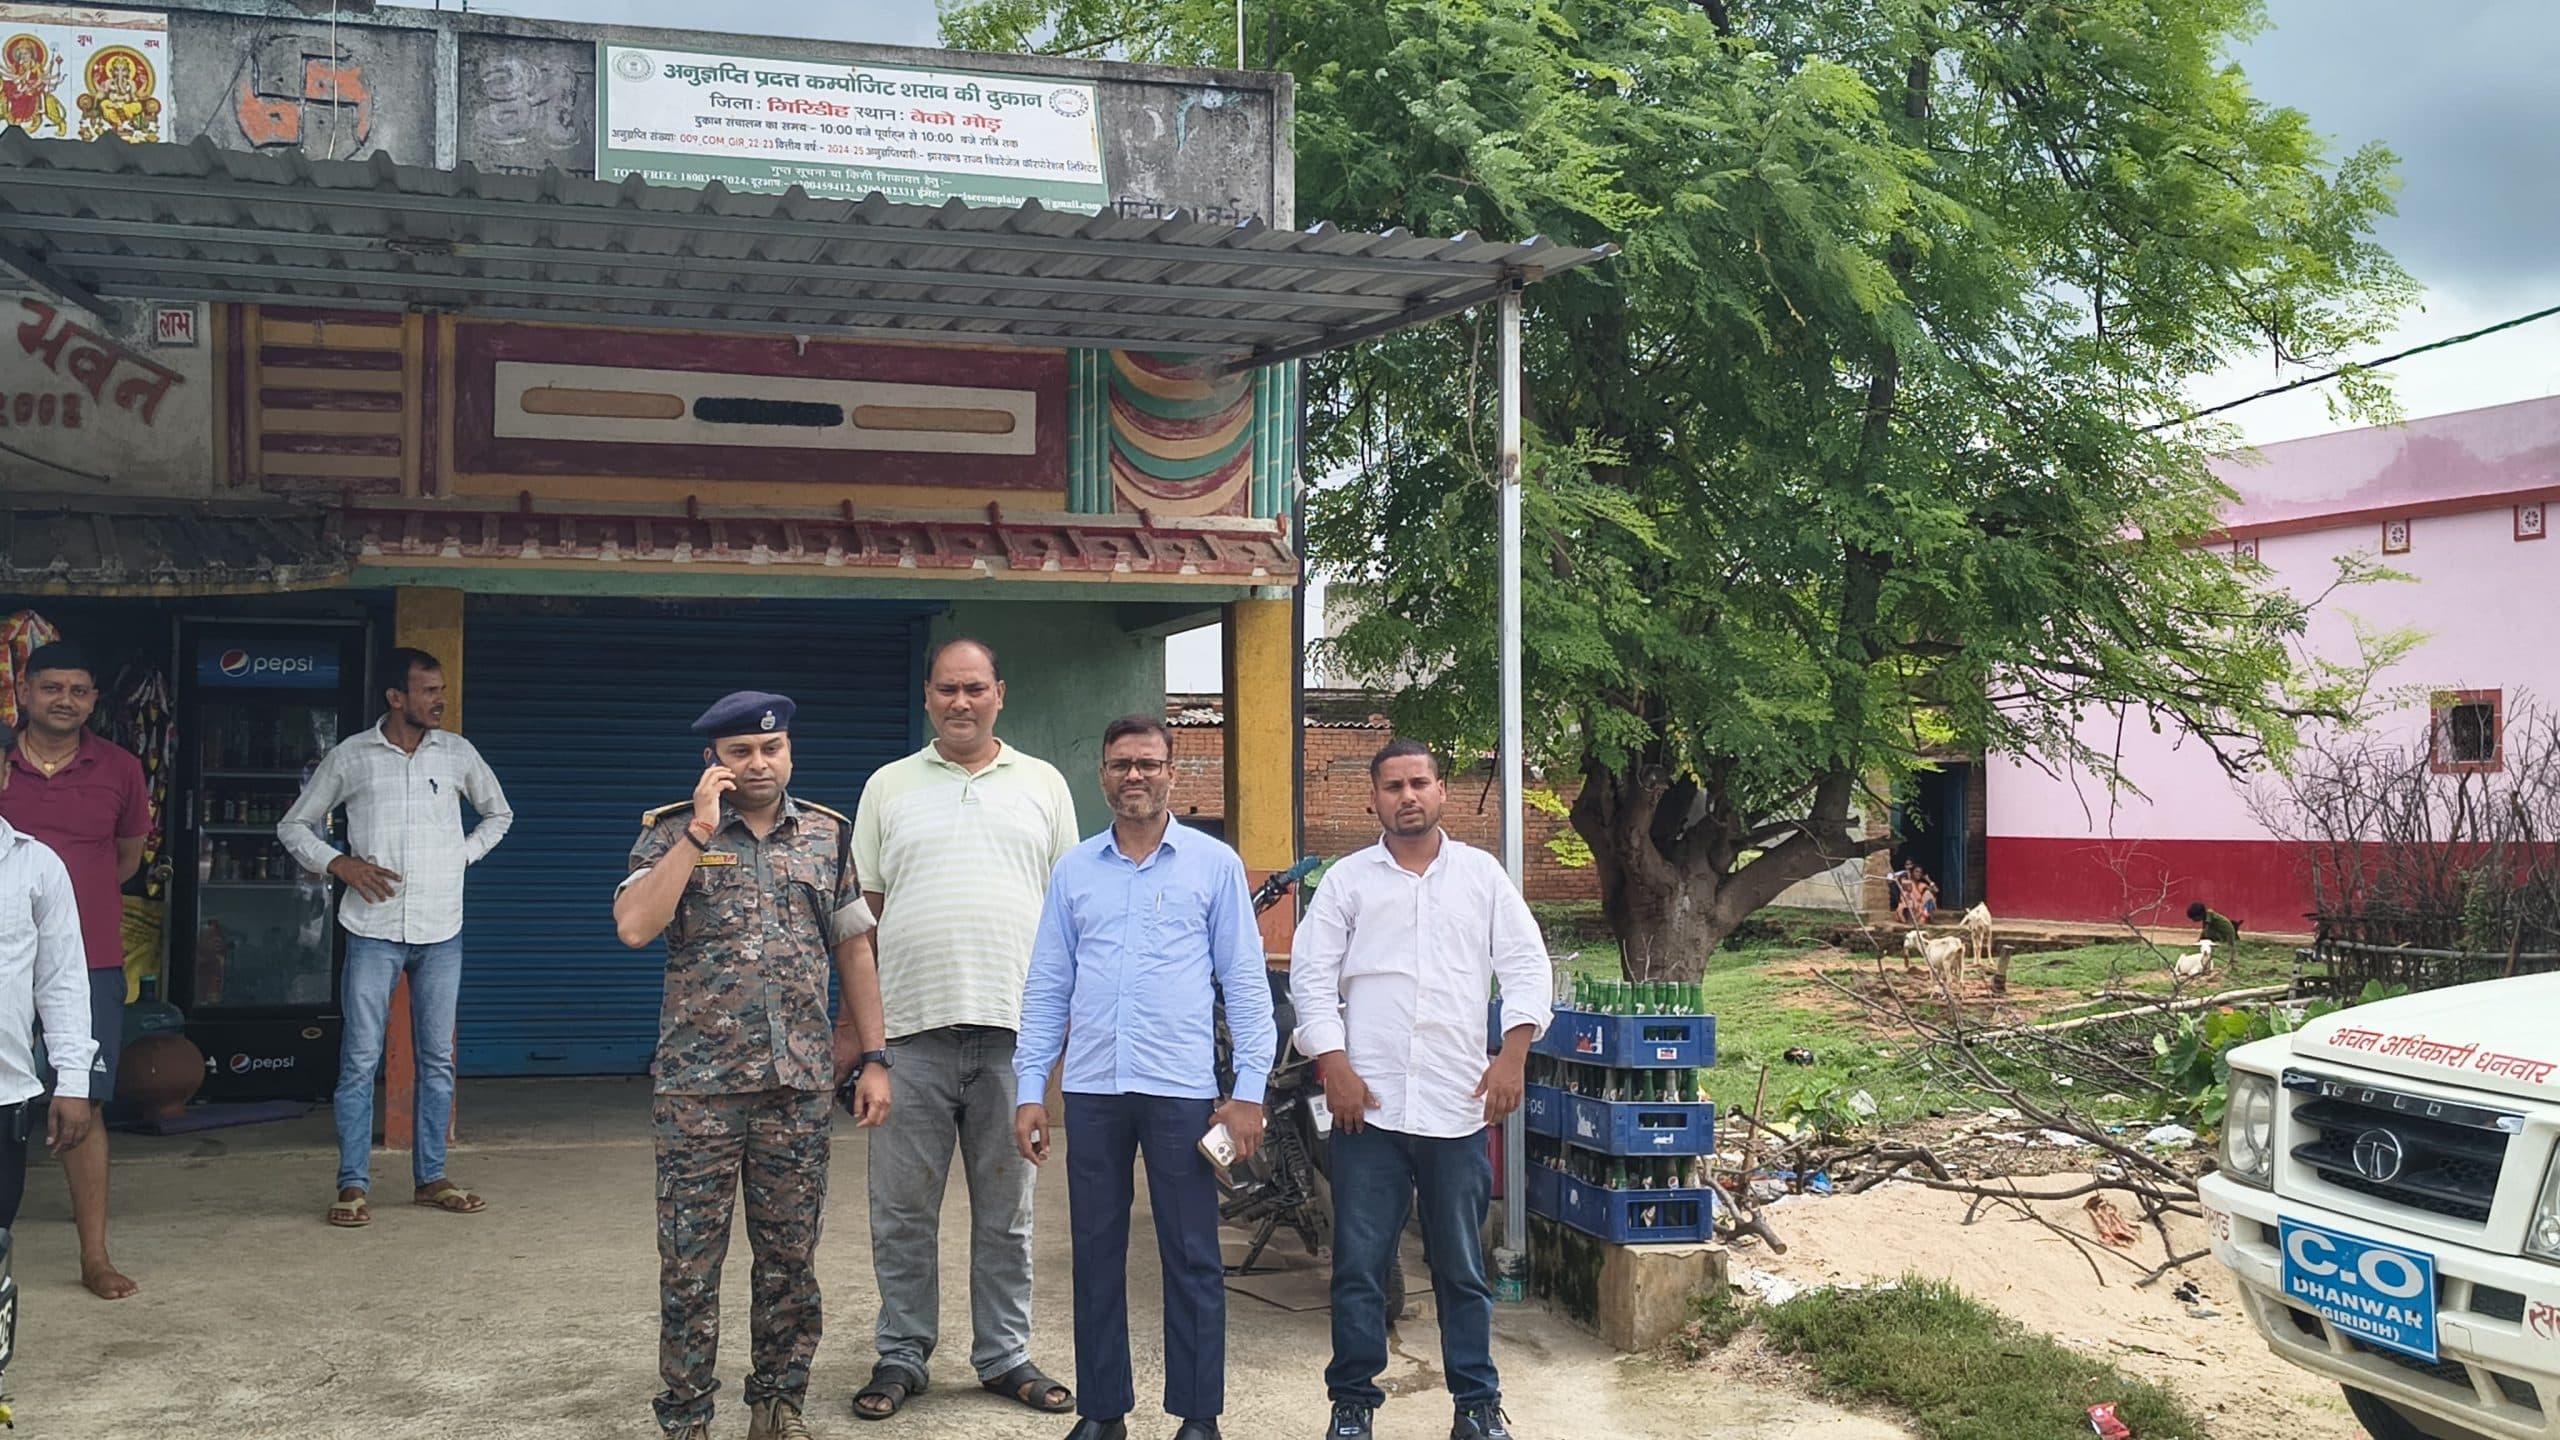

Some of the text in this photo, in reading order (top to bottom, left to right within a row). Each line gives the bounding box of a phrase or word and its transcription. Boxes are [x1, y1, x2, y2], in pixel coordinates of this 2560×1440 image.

[663, 62, 748, 86] अनुज्ञप्ति
[754, 70, 800, 88] प्रदत्त
[954, 82, 980, 103] की
[986, 90, 1042, 110] दुकान
[694, 116, 721, 128] दुकान
[765, 120, 778, 130] का
[781, 121, 807, 132] समय
[820, 124, 853, 136] 10:00
[855, 126, 871, 137] बजे
[908, 129, 918, 140] से
[922, 131, 954, 144] 10:00
[767, 97, 850, 118] गिरिडीह
[962, 113, 1003, 133] मोड़
[159, 312, 191, 340] लाभ
[17, 297, 186, 428] भवन
[253, 656, 313, 675] pepsi
[252, 1056, 295, 1071] pepsi
[2380, 1033, 2479, 1068] अधिकारी
[2475, 1051, 2558, 1084] धनवार
[2287, 1229, 2425, 1298] C.O
[2293, 1275, 2423, 1330] DHANWAR
